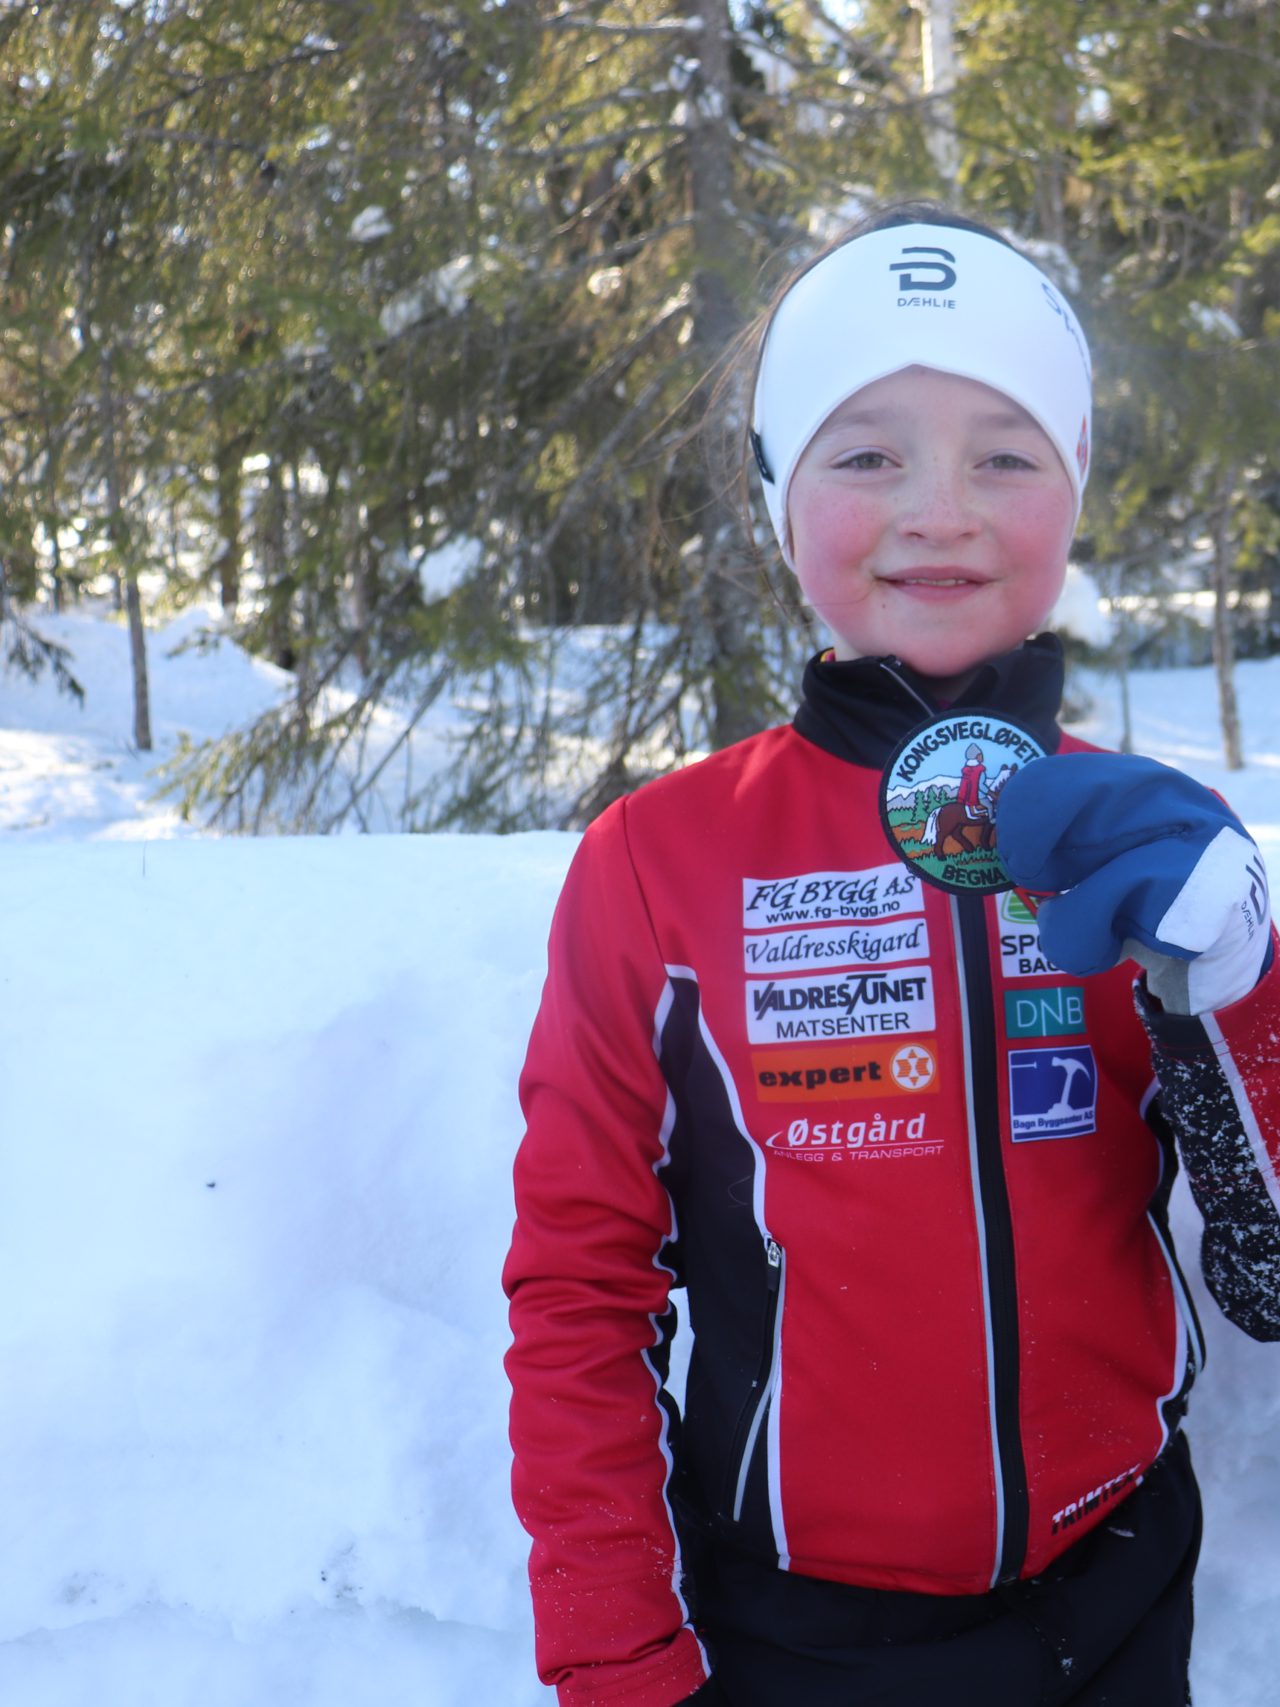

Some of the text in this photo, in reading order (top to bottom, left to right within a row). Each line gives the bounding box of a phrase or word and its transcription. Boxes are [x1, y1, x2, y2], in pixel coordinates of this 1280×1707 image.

[896, 297, 956, 309] DÆHLIE
[896, 721, 1040, 782] KONGSVEGLØPET
[745, 875, 916, 912] FG BYGG AS
[766, 901, 900, 924] www.fg-bygg.no
[745, 922, 925, 964] Valdresskigard
[1000, 934, 1042, 956] SP
[776, 1012, 911, 1039] MATSENTER
[1016, 987, 1083, 1037] DNB
[758, 1061, 883, 1090] expert
[786, 1113, 926, 1148] Østgård
[831, 1152, 843, 1162] &
[850, 1145, 945, 1161] TRANSPORT
